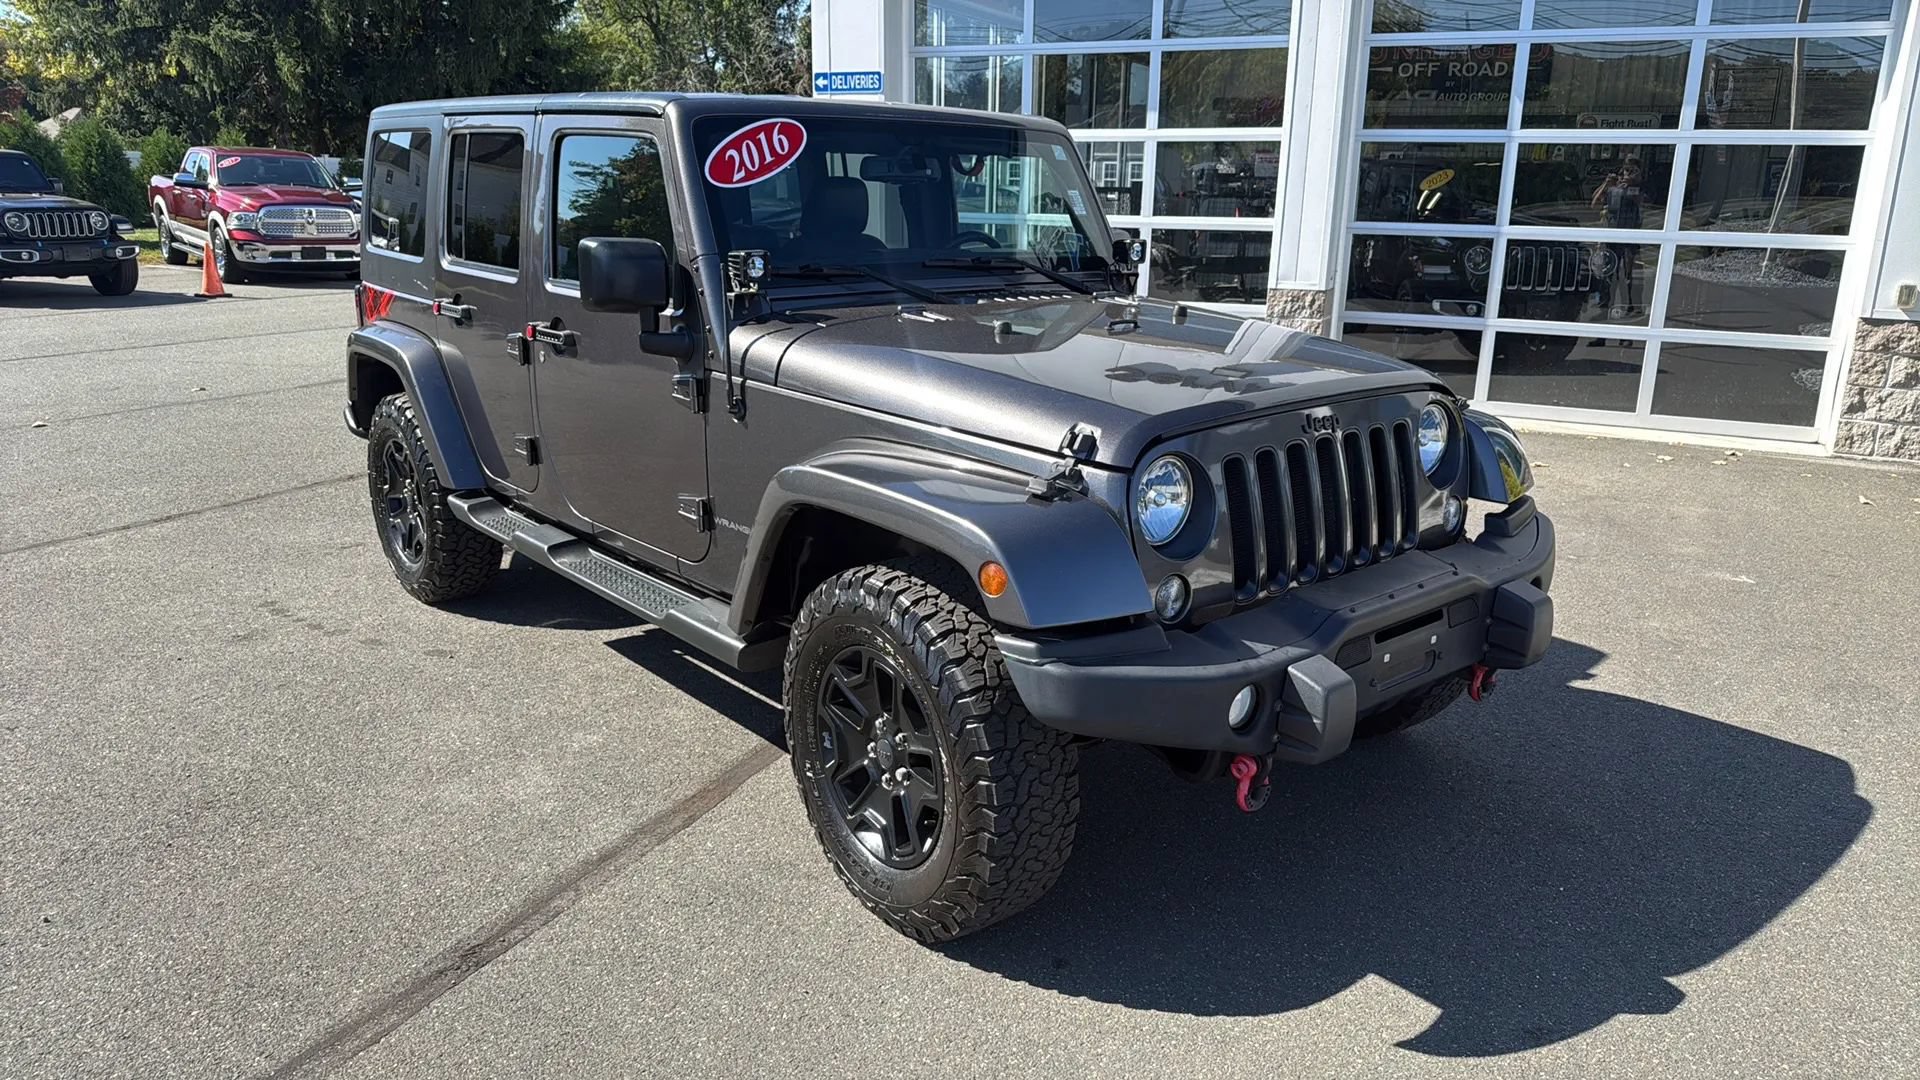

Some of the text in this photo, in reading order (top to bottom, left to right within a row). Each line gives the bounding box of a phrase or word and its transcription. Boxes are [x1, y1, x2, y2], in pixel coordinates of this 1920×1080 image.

[1398, 62, 1508, 78] OFF ROAD
[831, 74, 879, 89] DELIVERIES
[1437, 92, 1467, 101] AUTO
[1469, 92, 1509, 102] GROUP
[1600, 119, 1652, 129] Fight Rust!
[725, 122, 789, 183] 2016
[1425, 170, 1449, 188] 2023
[1301, 413, 1340, 434] Jeep
